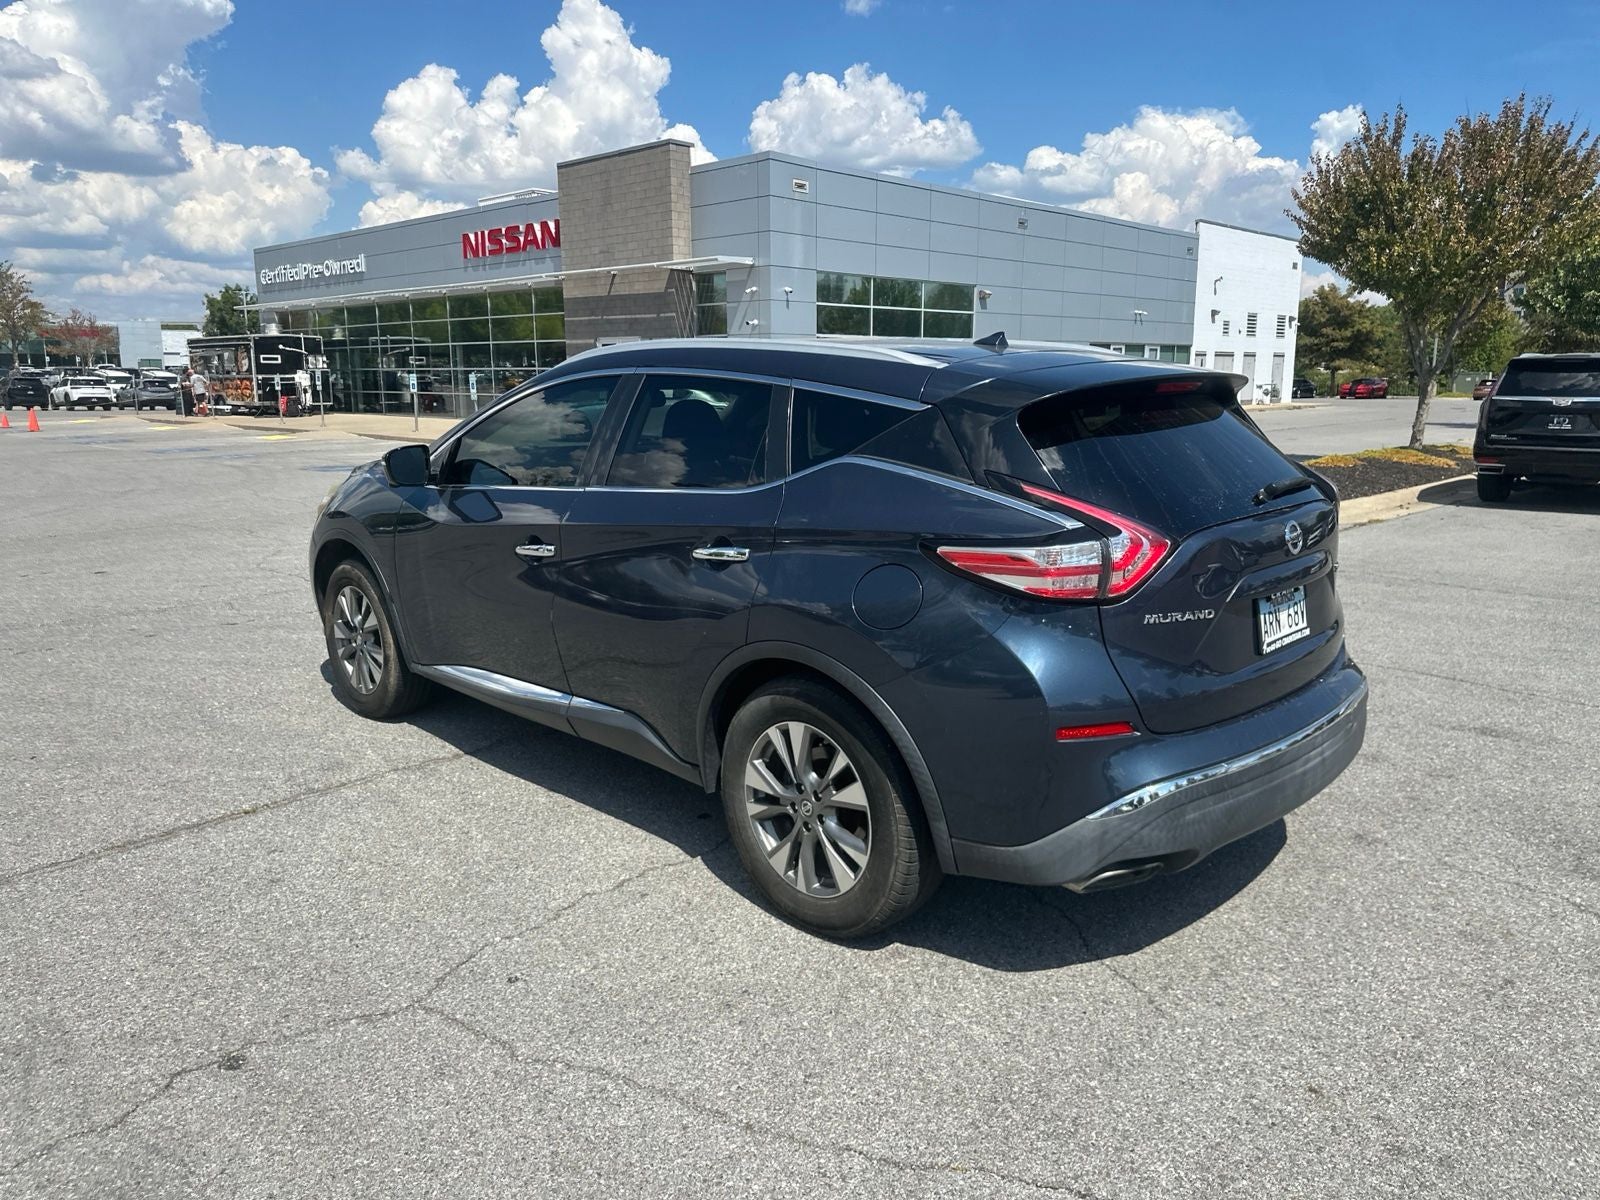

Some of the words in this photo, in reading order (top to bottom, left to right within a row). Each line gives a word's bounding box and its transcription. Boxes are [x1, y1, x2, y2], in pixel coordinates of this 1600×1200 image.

[462, 219, 561, 259] NISSAN
[260, 262, 303, 284] Certified
[302, 253, 365, 280] Pre-Owned
